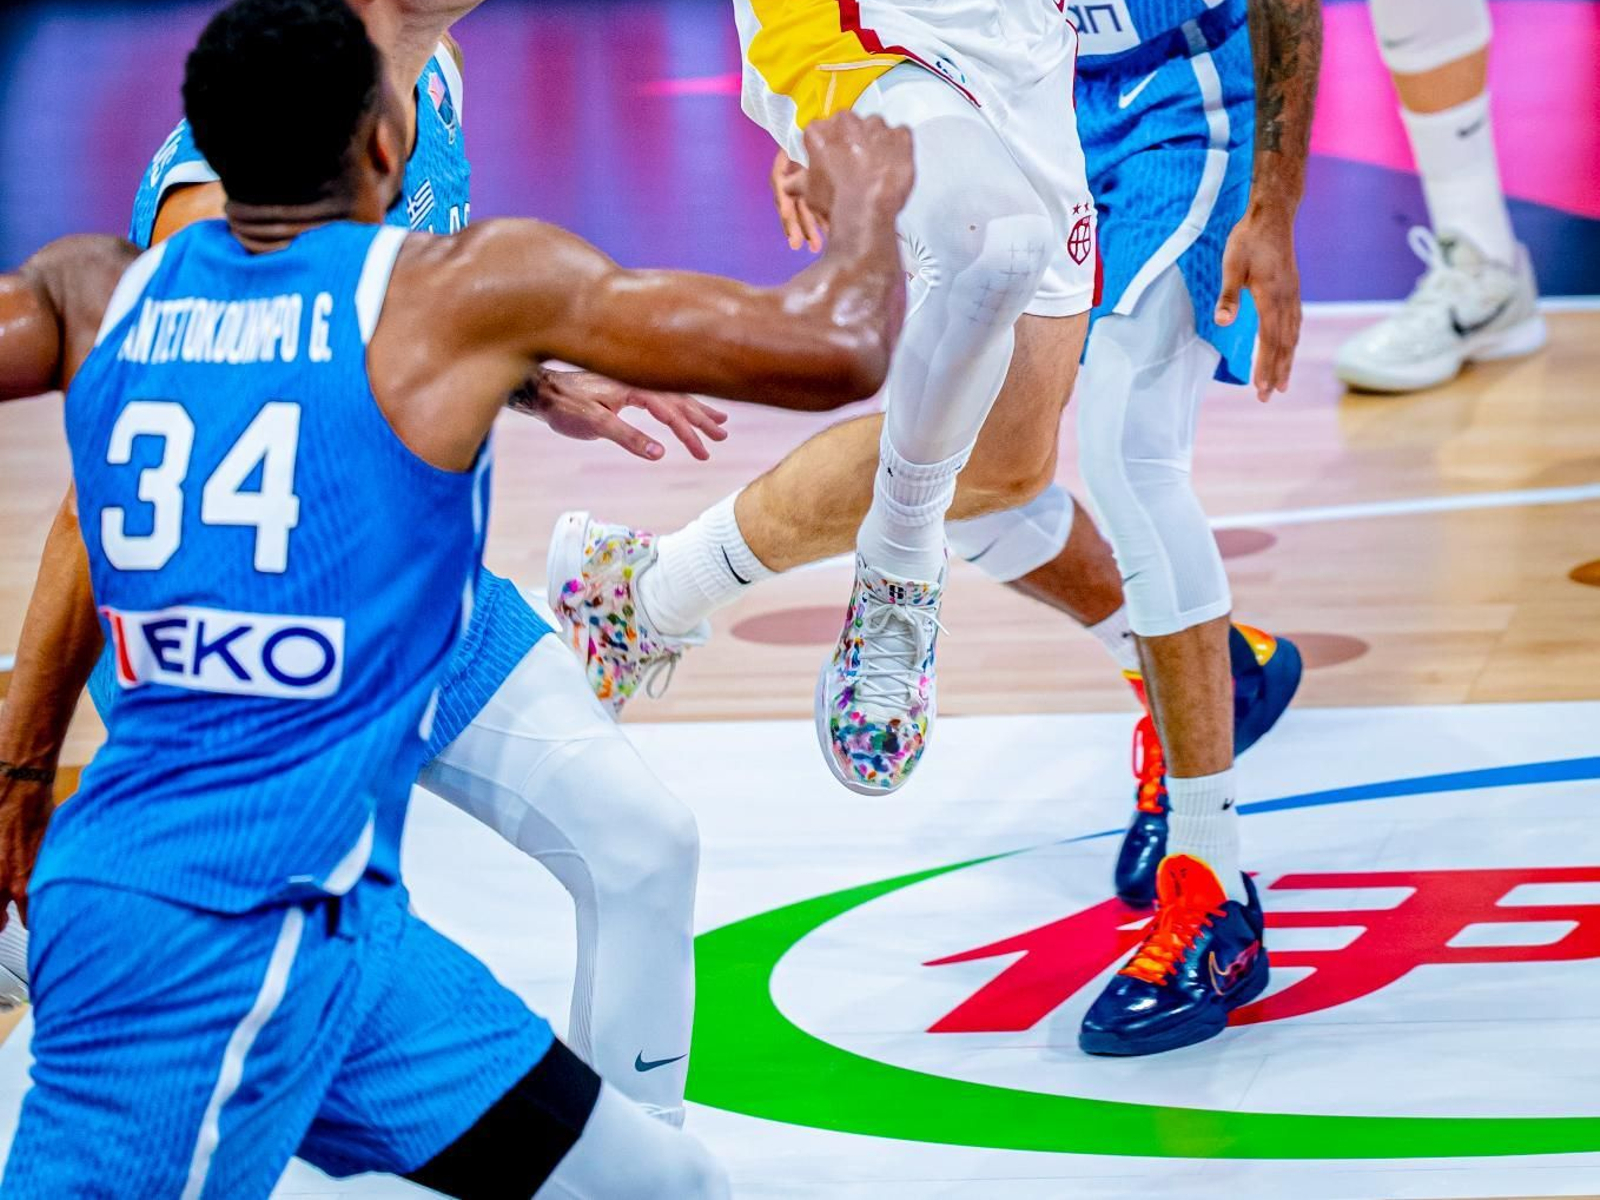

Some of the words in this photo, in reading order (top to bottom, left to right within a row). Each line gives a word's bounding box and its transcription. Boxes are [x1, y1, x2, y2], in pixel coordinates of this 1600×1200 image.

[308, 290, 334, 364] G.
[100, 400, 302, 574] 34
[141, 618, 337, 688] EKO
